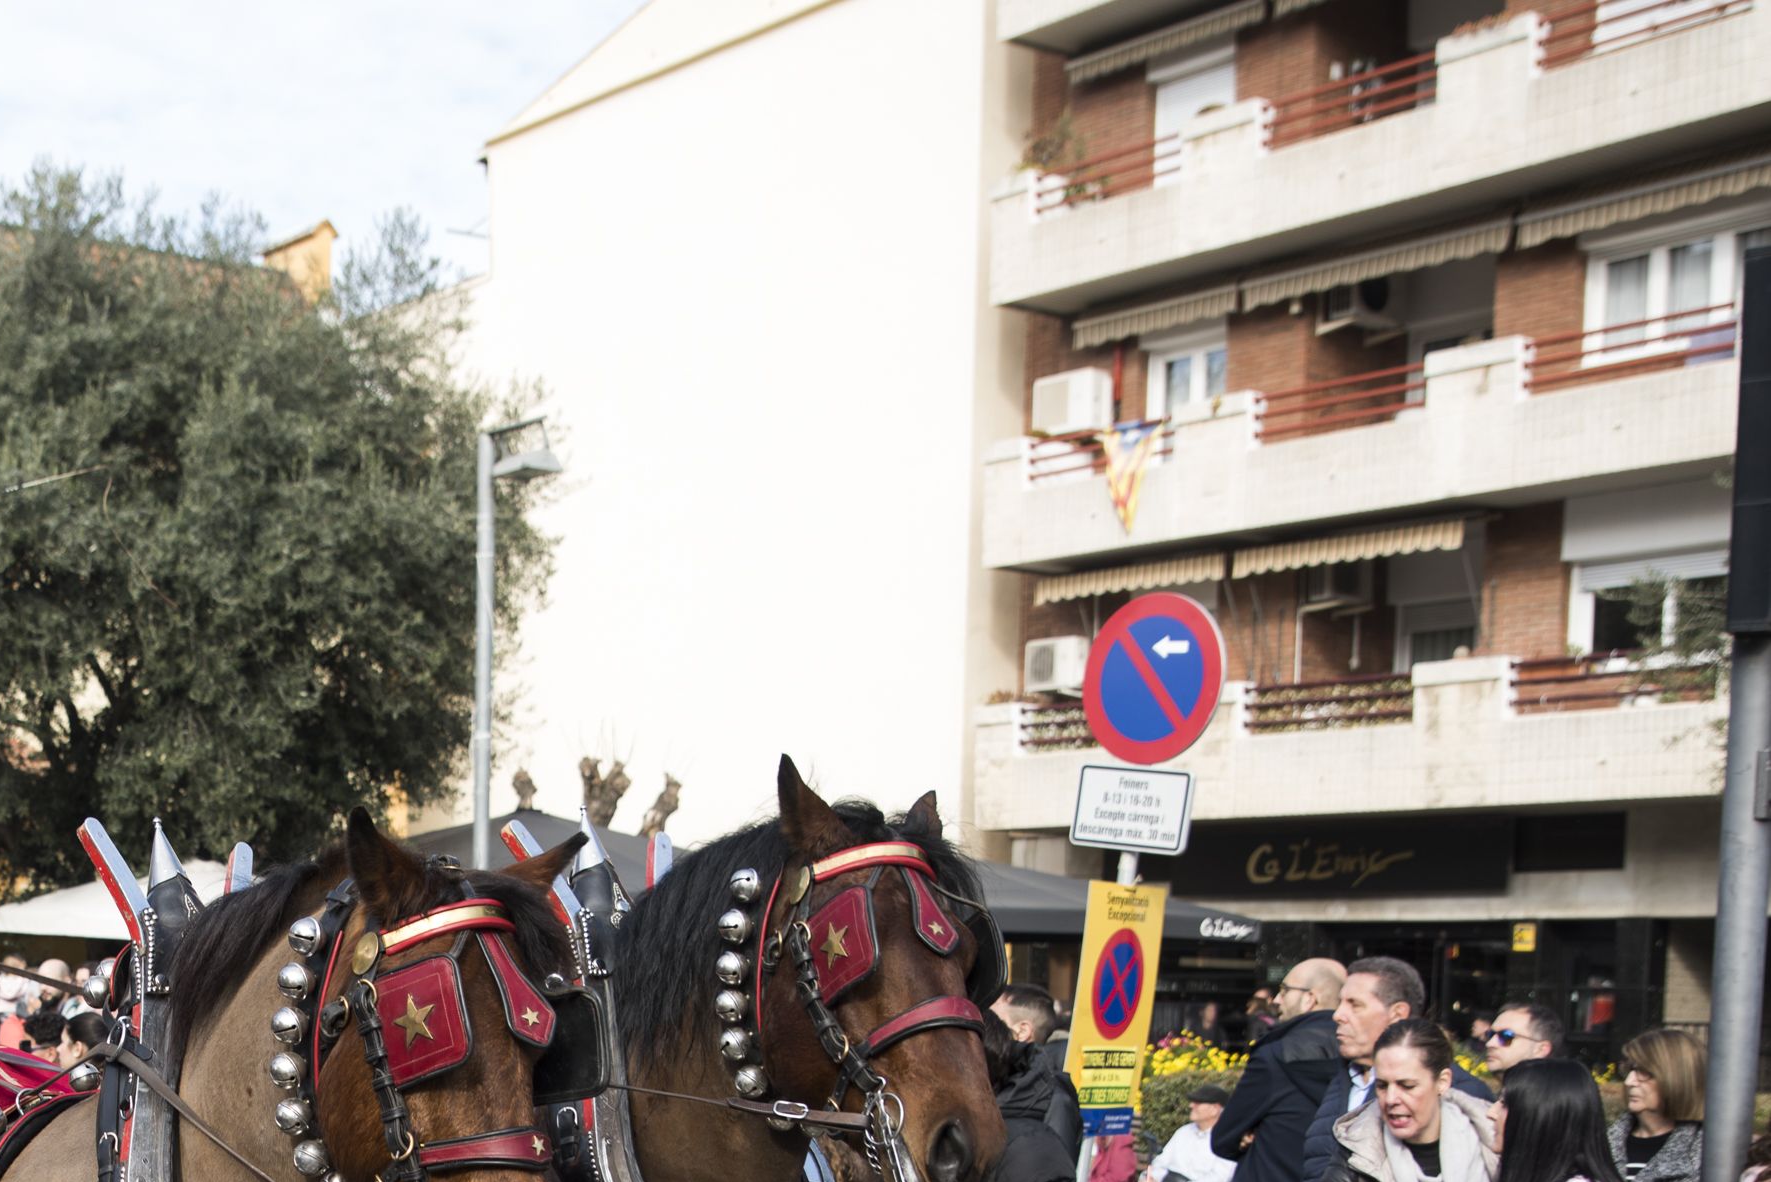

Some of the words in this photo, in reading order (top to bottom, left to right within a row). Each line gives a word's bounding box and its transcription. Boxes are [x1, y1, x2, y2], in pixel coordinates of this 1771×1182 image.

[1119, 776, 1149, 790] Feiners
[1103, 792, 1122, 805] 8-13
[1129, 794, 1153, 807] 16-20
[1094, 807, 1125, 822] Excepte
[1147, 828, 1158, 841] 30
[1159, 829, 1176, 842] min
